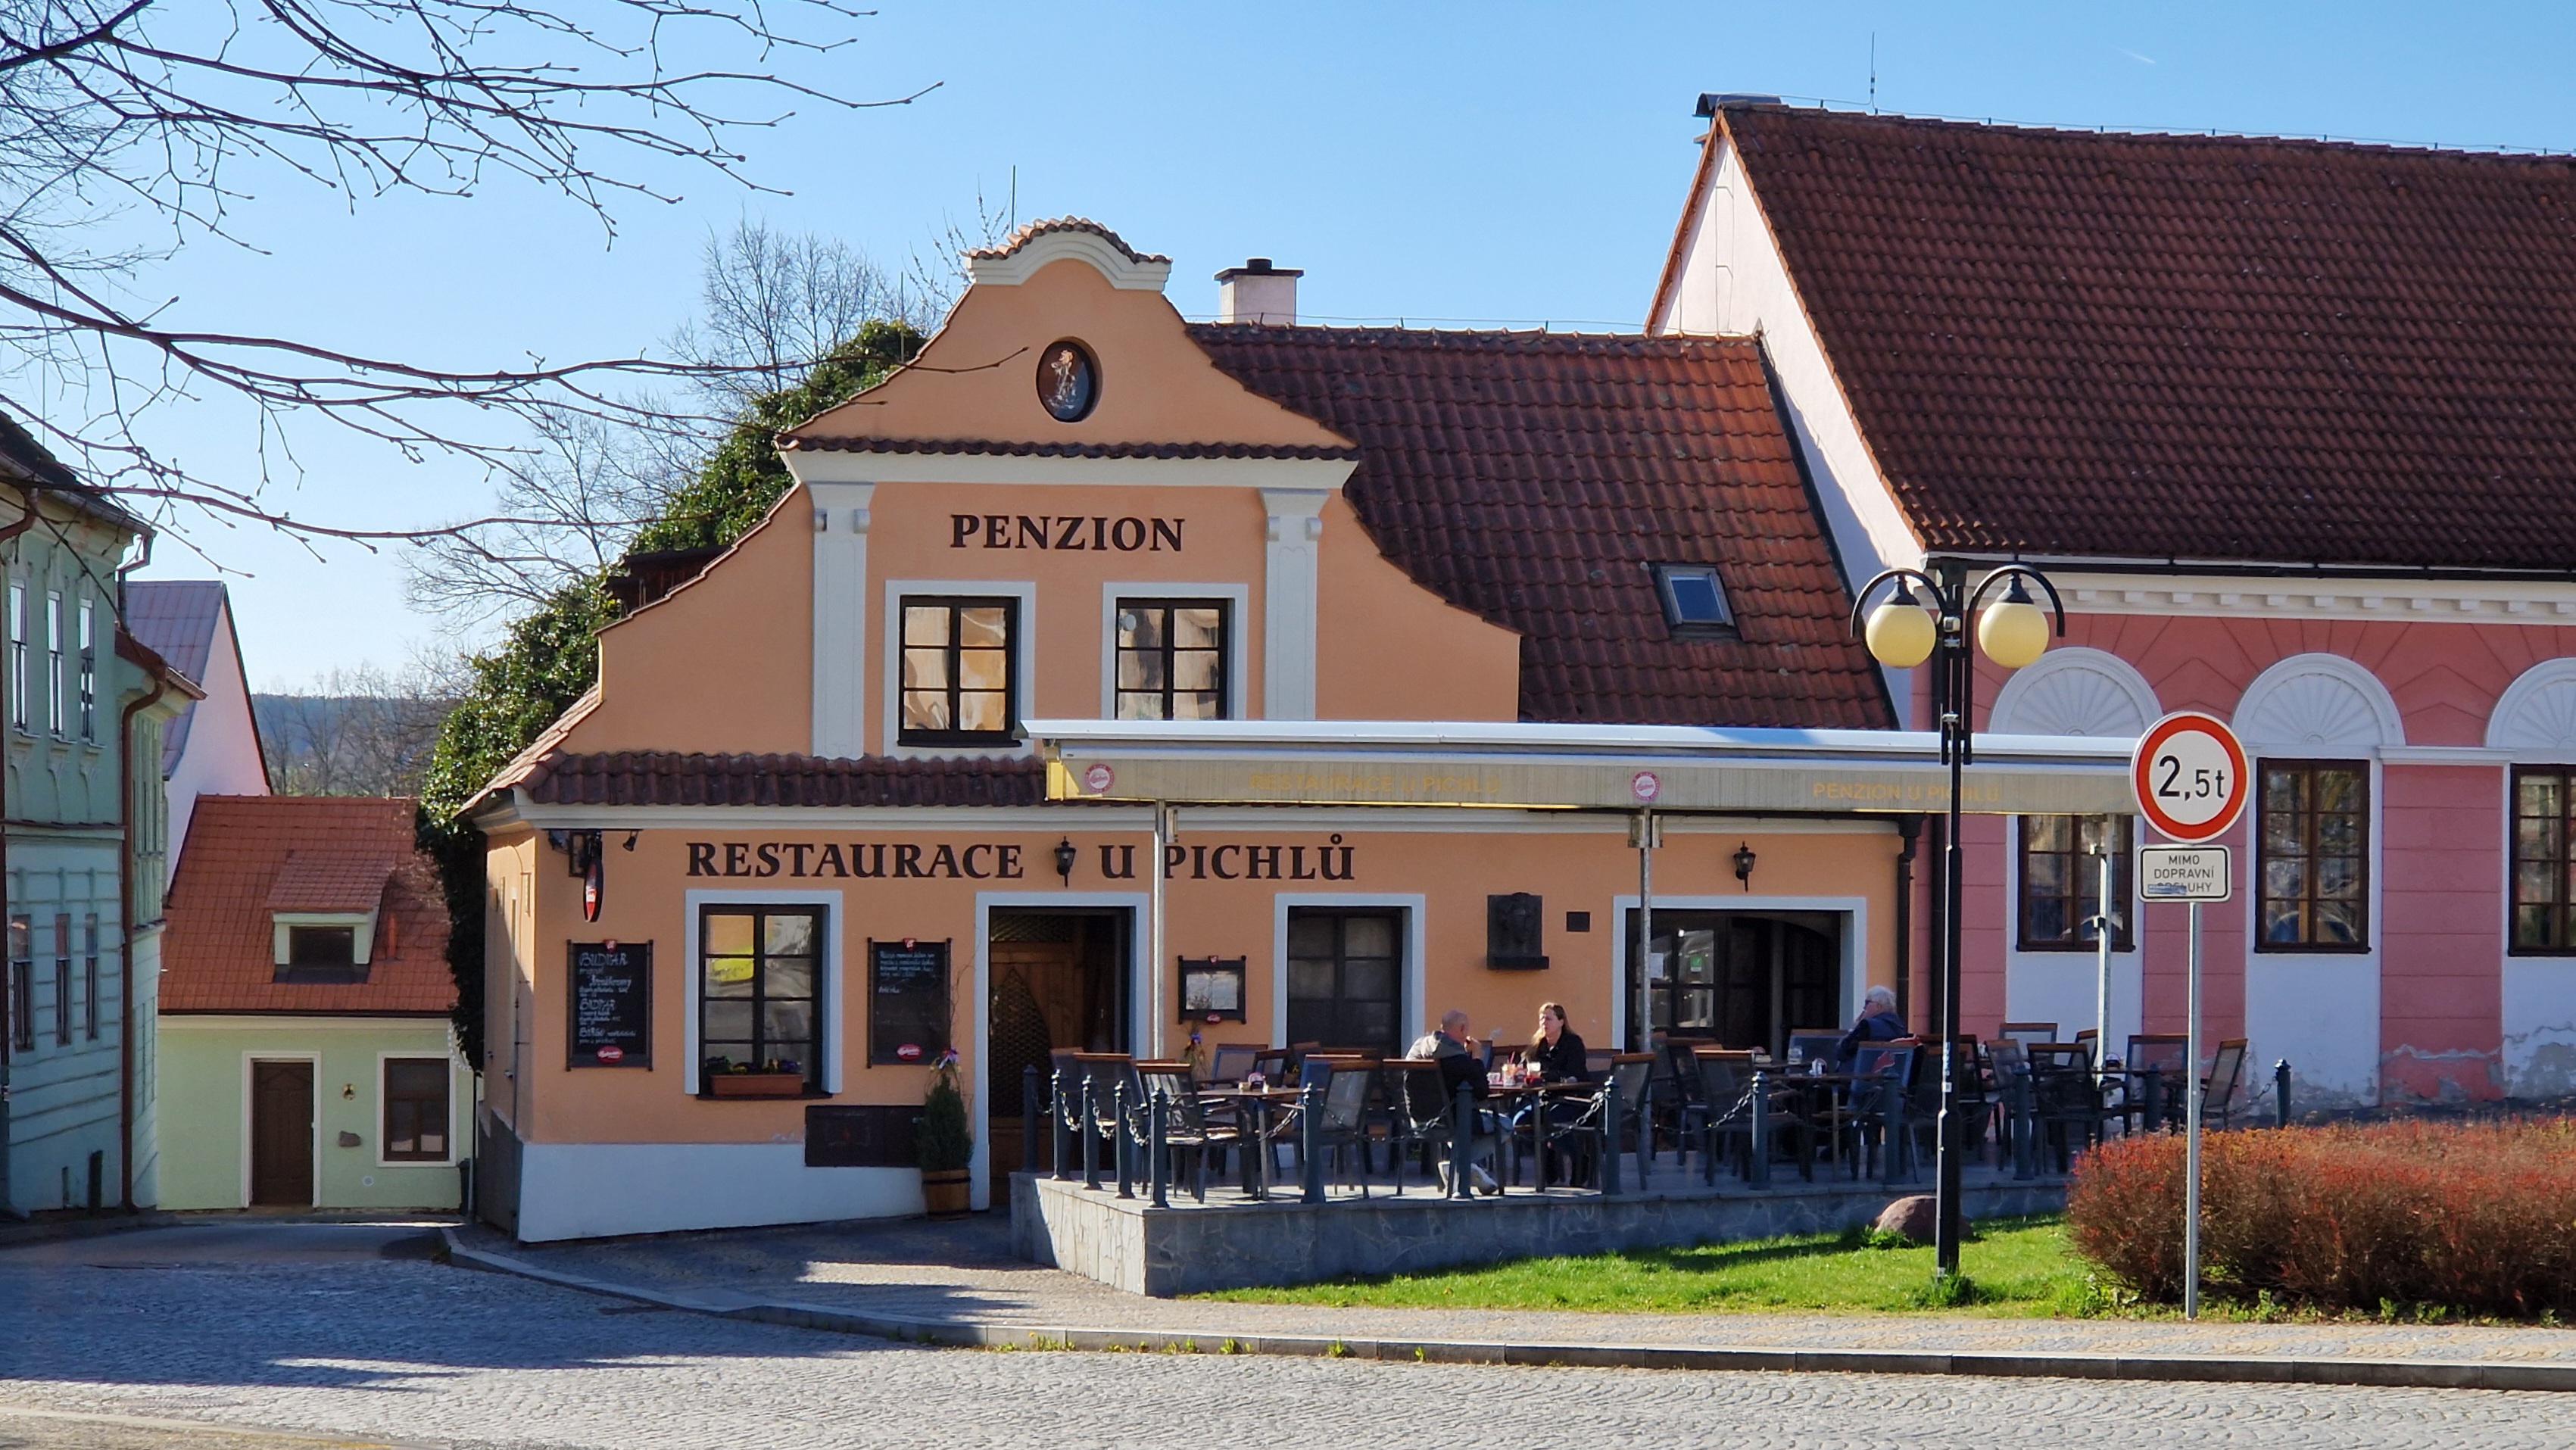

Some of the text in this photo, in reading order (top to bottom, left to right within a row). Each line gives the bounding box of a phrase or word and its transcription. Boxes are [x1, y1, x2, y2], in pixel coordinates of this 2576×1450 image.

[950, 514, 1185, 552] PENZION
[1251, 774, 1393, 792] RESTAURACE
[1402, 775, 1415, 793] U
[1813, 783, 1900, 800] PENZION
[1908, 784, 1922, 800] U
[685, 834, 1355, 880] RESTAURACE U PICHLŮ
[2169, 855, 2200, 865] MIMO
[2154, 865, 2214, 879] DOPRAVNÍ
